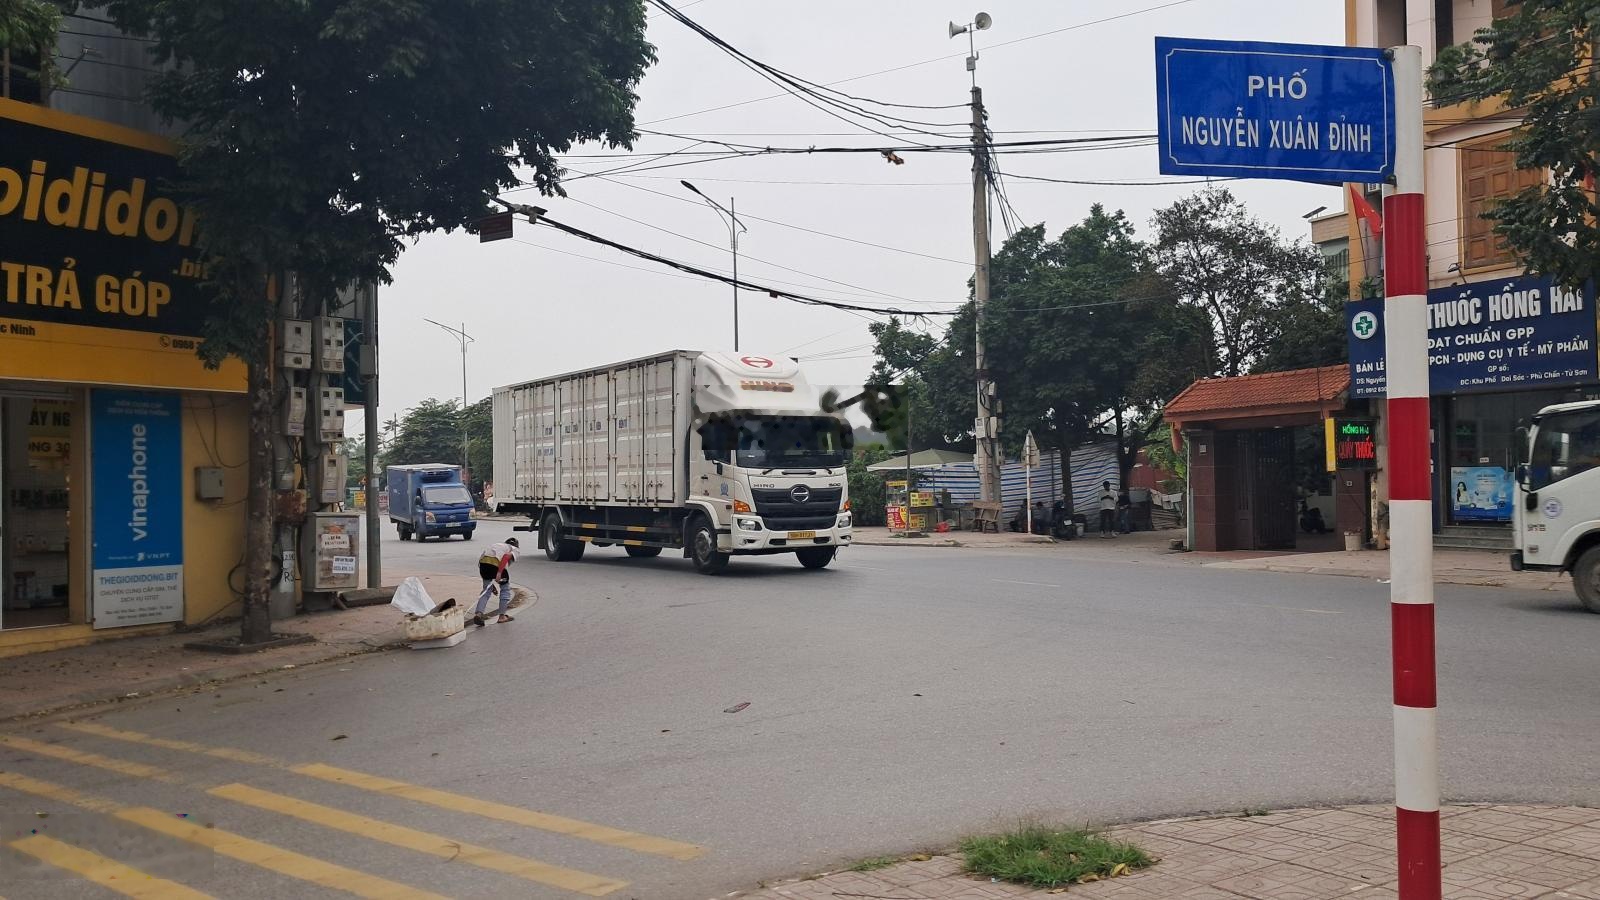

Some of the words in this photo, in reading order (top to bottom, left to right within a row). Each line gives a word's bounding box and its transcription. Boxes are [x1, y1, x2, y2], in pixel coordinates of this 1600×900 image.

[1248, 68, 1308, 100] PHỐ
[1182, 106, 1259, 148] NGUYỄN
[1269, 114, 1319, 150] XUÂN
[1328, 114, 1371, 153] ĐỈNH
[1, 257, 82, 310] TRẢ
[95, 271, 171, 318] GÓP
[1427, 290, 1482, 330] THUỐC
[1488, 282, 1541, 322] HỒNG
[10, 323, 36, 336] Ninh
[1427, 336, 1451, 351] ĐẠT
[1455, 326, 1500, 346] CHUẨN
[1506, 326, 1535, 340] GPP
[1356, 359, 1374, 373] BÁN
[1376, 357, 1385, 371] LẺ
[1428, 354, 1450, 366] PCN
[1457, 350, 1485, 365] DỤNG
[1488, 349, 1503, 362] CỤ
[1507, 347, 1514, 358] Y
[1517, 341, 1529, 357] TẾ
[1537, 340, 1553, 355] MỸ
[1557, 334, 1589, 353] PHẨM
[1487, 365, 1498, 373] GP
[128, 424, 150, 542] vinaphone
